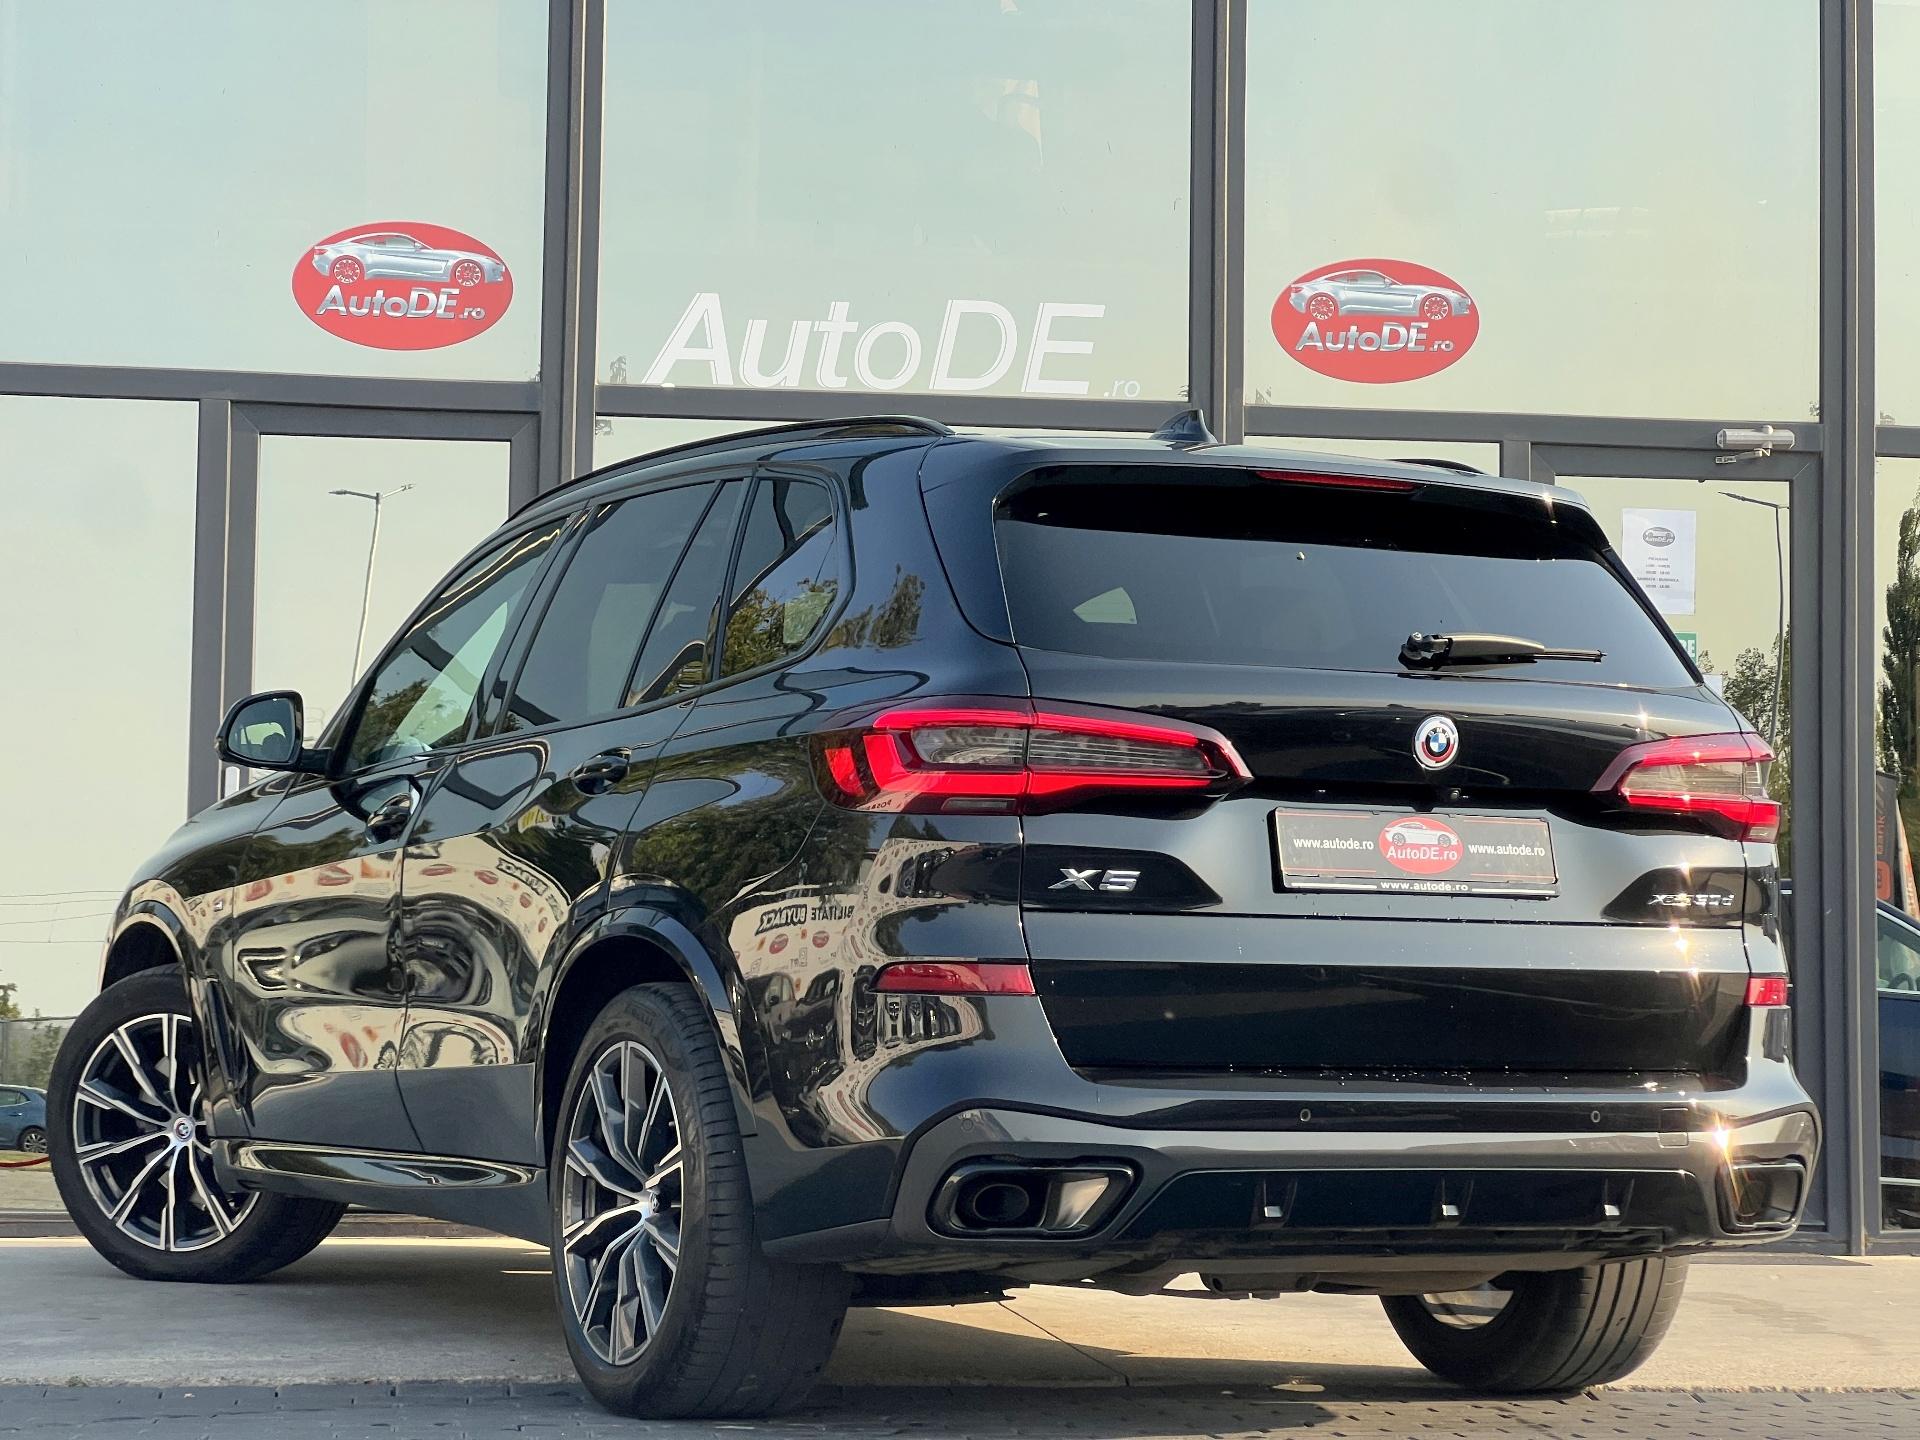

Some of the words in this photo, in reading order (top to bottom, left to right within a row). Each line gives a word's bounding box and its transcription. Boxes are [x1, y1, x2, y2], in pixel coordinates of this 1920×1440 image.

[1293, 837, 1374, 851] www.autode.ro
[1468, 844, 1546, 857] www.autode.ro
[1386, 846, 1458, 862] AutoDE.ro
[1048, 868, 1141, 892] X5
[1381, 880, 1469, 892] www.autode.ro
